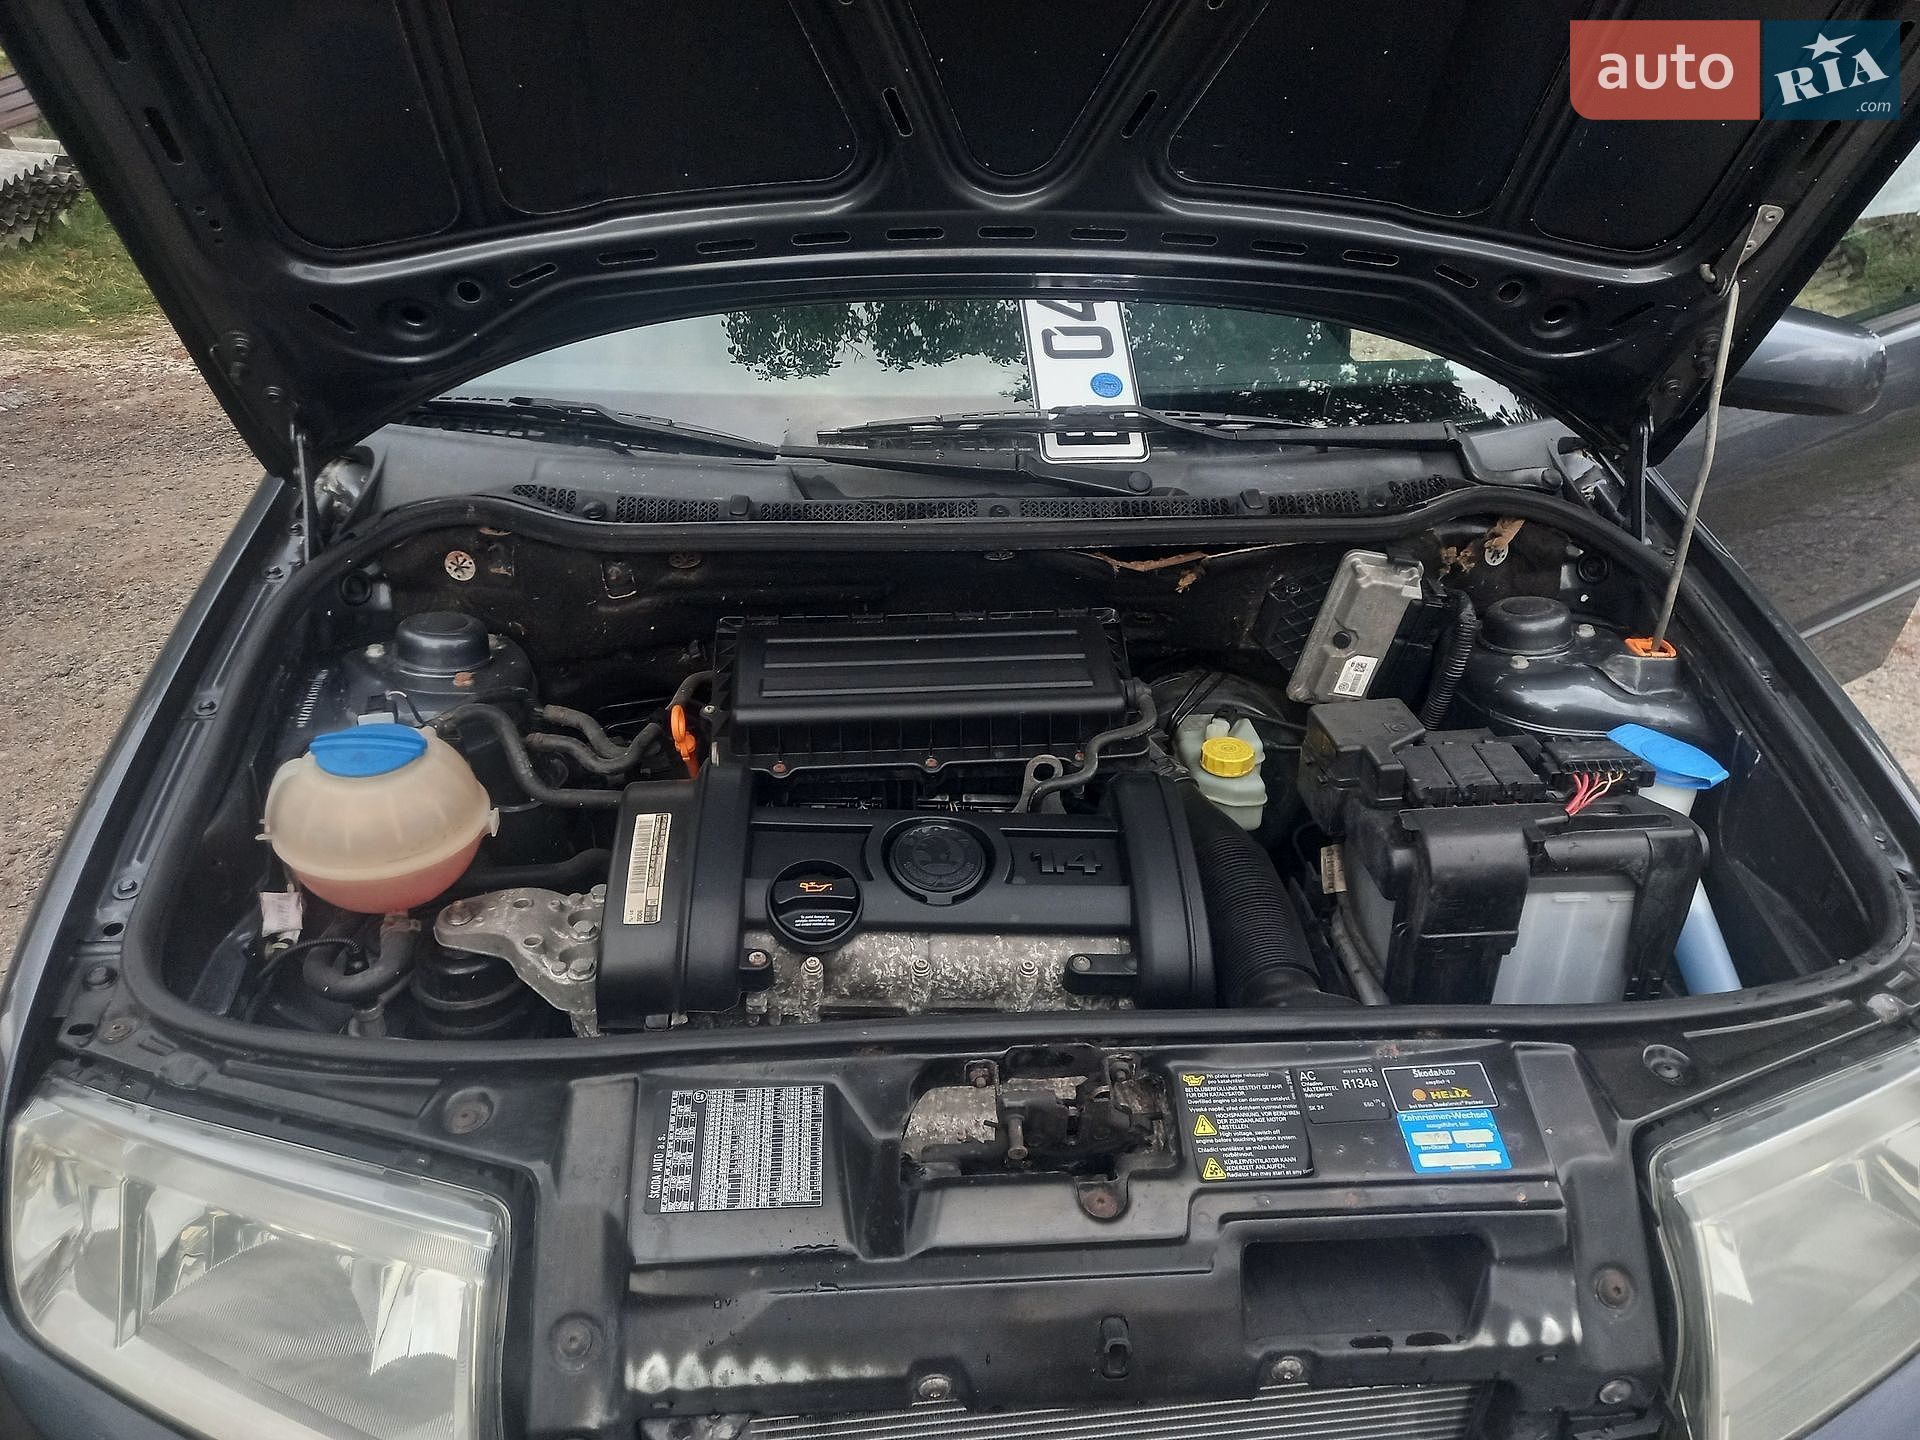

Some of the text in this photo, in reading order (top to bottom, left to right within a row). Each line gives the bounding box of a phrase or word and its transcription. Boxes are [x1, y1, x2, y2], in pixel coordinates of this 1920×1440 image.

[1300, 1071, 1316, 1081] AC
[1341, 1078, 1379, 1089] R134a
[1430, 1087, 1472, 1100] HELIX
[1401, 1111, 1489, 1122] Zahnriemen-Wechsel
[648, 1133, 667, 1199] ŠKODA AUTO a.s.
